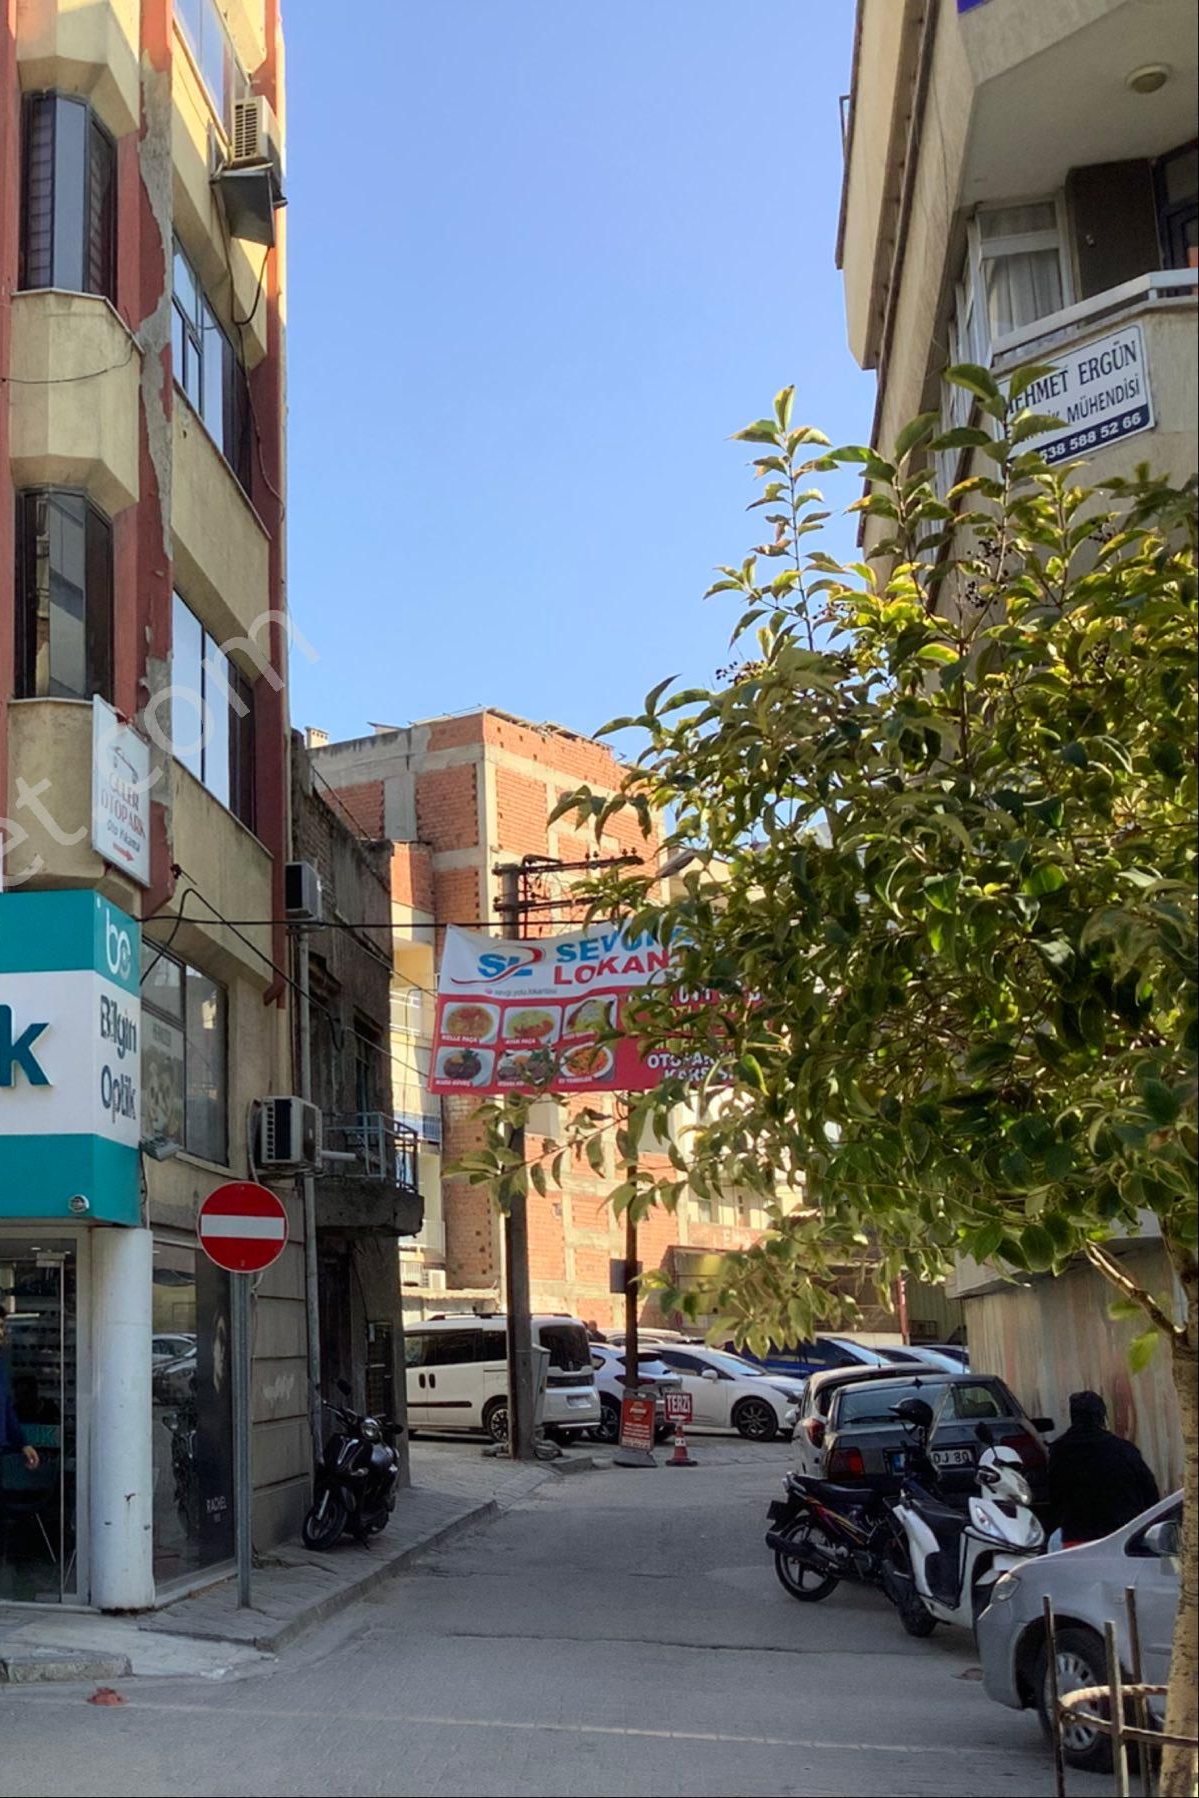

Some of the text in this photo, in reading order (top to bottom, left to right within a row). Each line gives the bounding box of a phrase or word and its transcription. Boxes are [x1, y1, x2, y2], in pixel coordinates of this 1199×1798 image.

[1077, 340, 1138, 386] ERGÜN
[1067, 373, 1140, 424] MÜHENDİSİ
[1069, 432, 1097, 451] 588
[1100, 422, 1119, 438] 52
[1122, 412, 1141, 429] 66
[100, 994, 137, 1060] Bilgin
[100, 1064, 137, 1124] Optik
